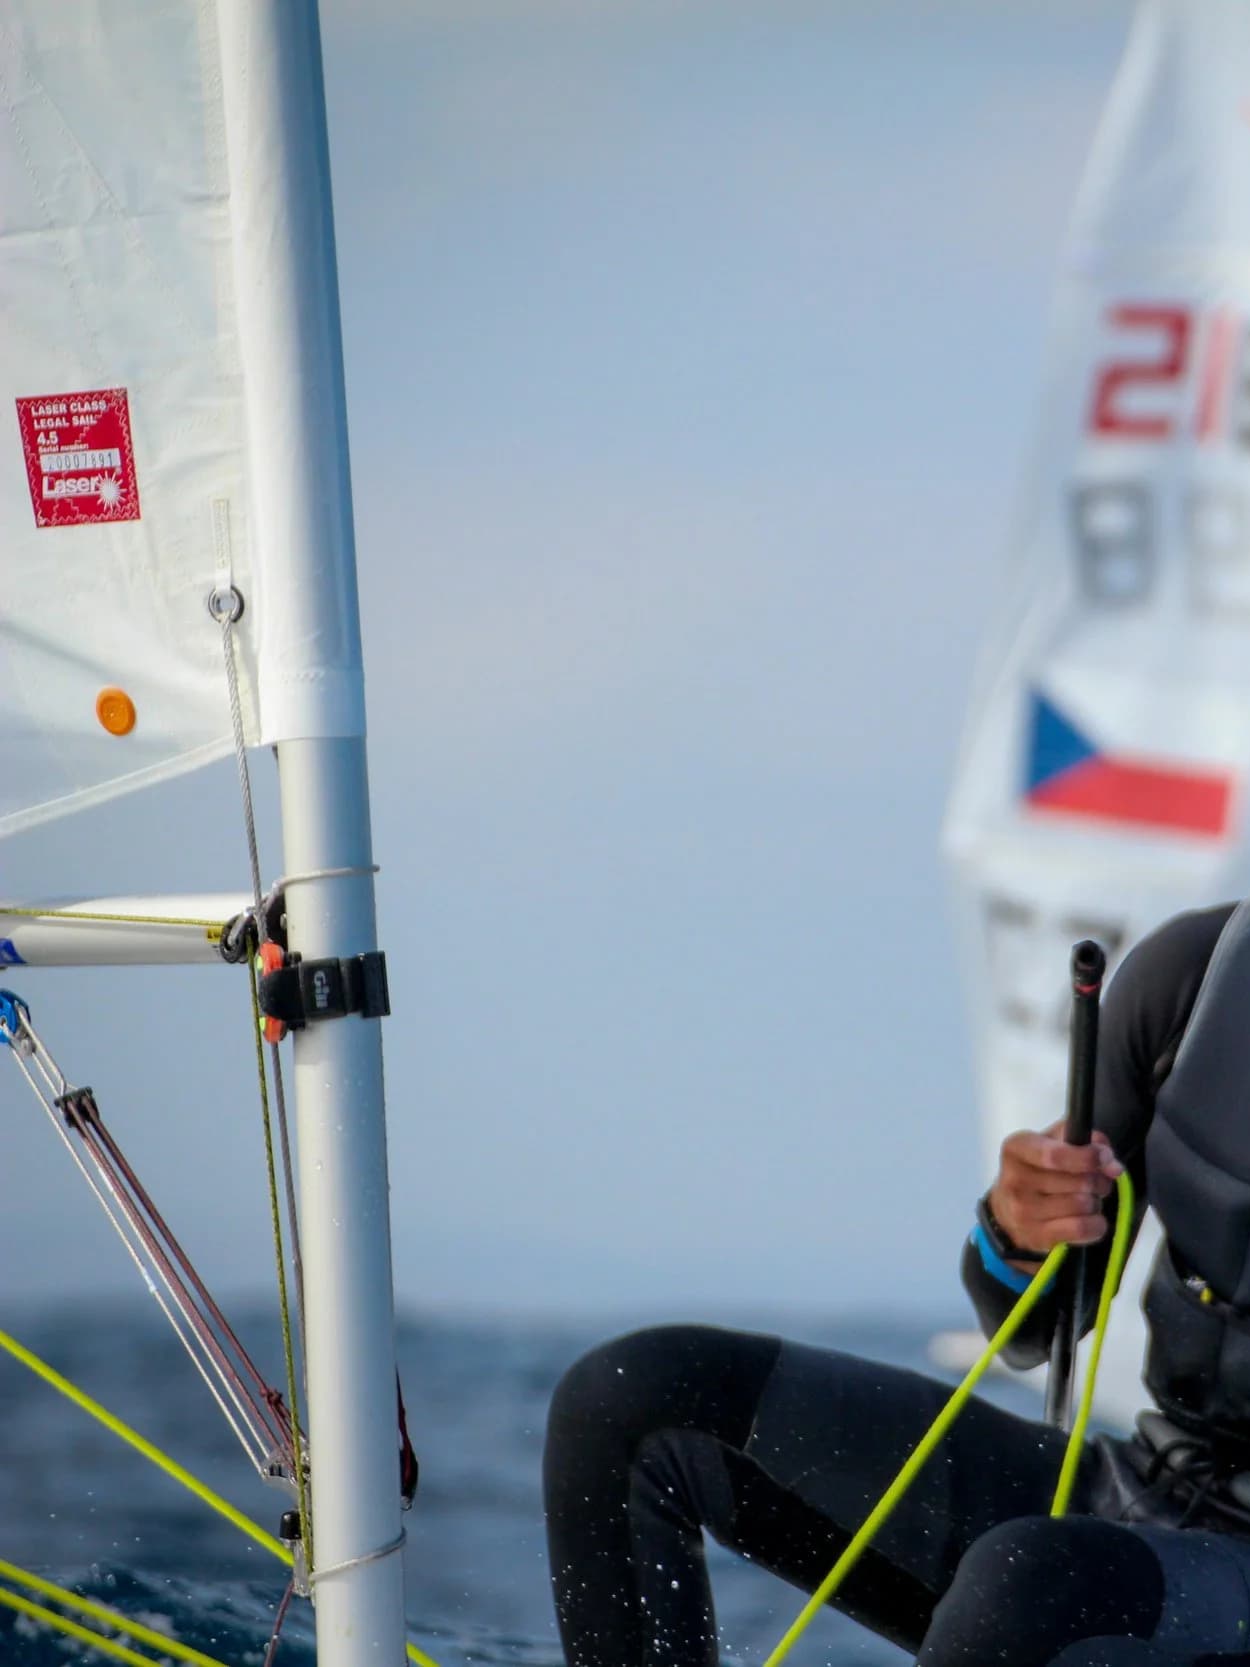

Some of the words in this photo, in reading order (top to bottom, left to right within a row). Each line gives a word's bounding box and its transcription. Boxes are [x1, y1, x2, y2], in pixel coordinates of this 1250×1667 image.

[31, 403, 67, 417] LASER
[70, 400, 107, 413] CLASS
[34, 417, 70, 430] LEGAL
[72, 414, 97, 427] SAIL
[37, 430, 58, 445] 4.5
[42, 475, 100, 499] Laser
